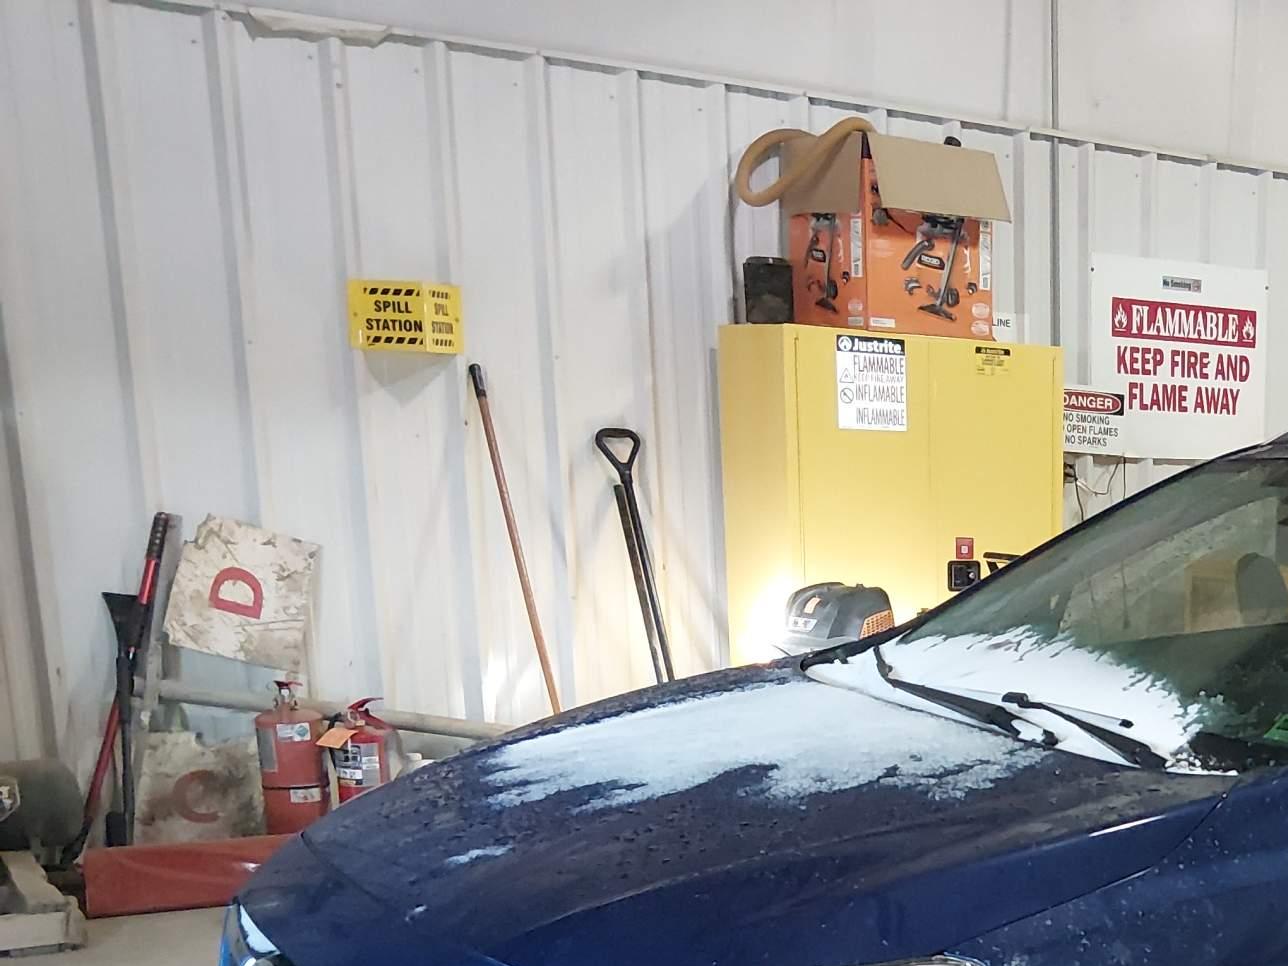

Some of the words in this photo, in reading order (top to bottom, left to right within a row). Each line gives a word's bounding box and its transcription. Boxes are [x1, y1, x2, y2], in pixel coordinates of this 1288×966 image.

[374, 300, 412, 313] SPILL
[366, 318, 423, 332] STATION
[1131, 304, 1239, 342] FLAMMABLE
[853, 338, 902, 354] Justrite
[853, 355, 904, 374] FLAMMABLE
[1117, 345, 1165, 376] KEEP
[1170, 349, 1210, 380] FIRE
[1214, 353, 1250, 382] AND
[856, 384, 904, 403] INFLAMABLE
[1128, 382, 1188, 412] FLAME
[1194, 386, 1240, 416] AWAY
[856, 407, 905, 426] INFLAMMABLE
[1076, 413, 1110, 425] SMOKING
[1066, 423, 1087, 435] OPEN
[1089, 425, 1119, 438] FLAMES
[1065, 434, 1075, 445] NO
[1077, 435, 1107, 447] SPARKS
[208, 566, 264, 619] D
